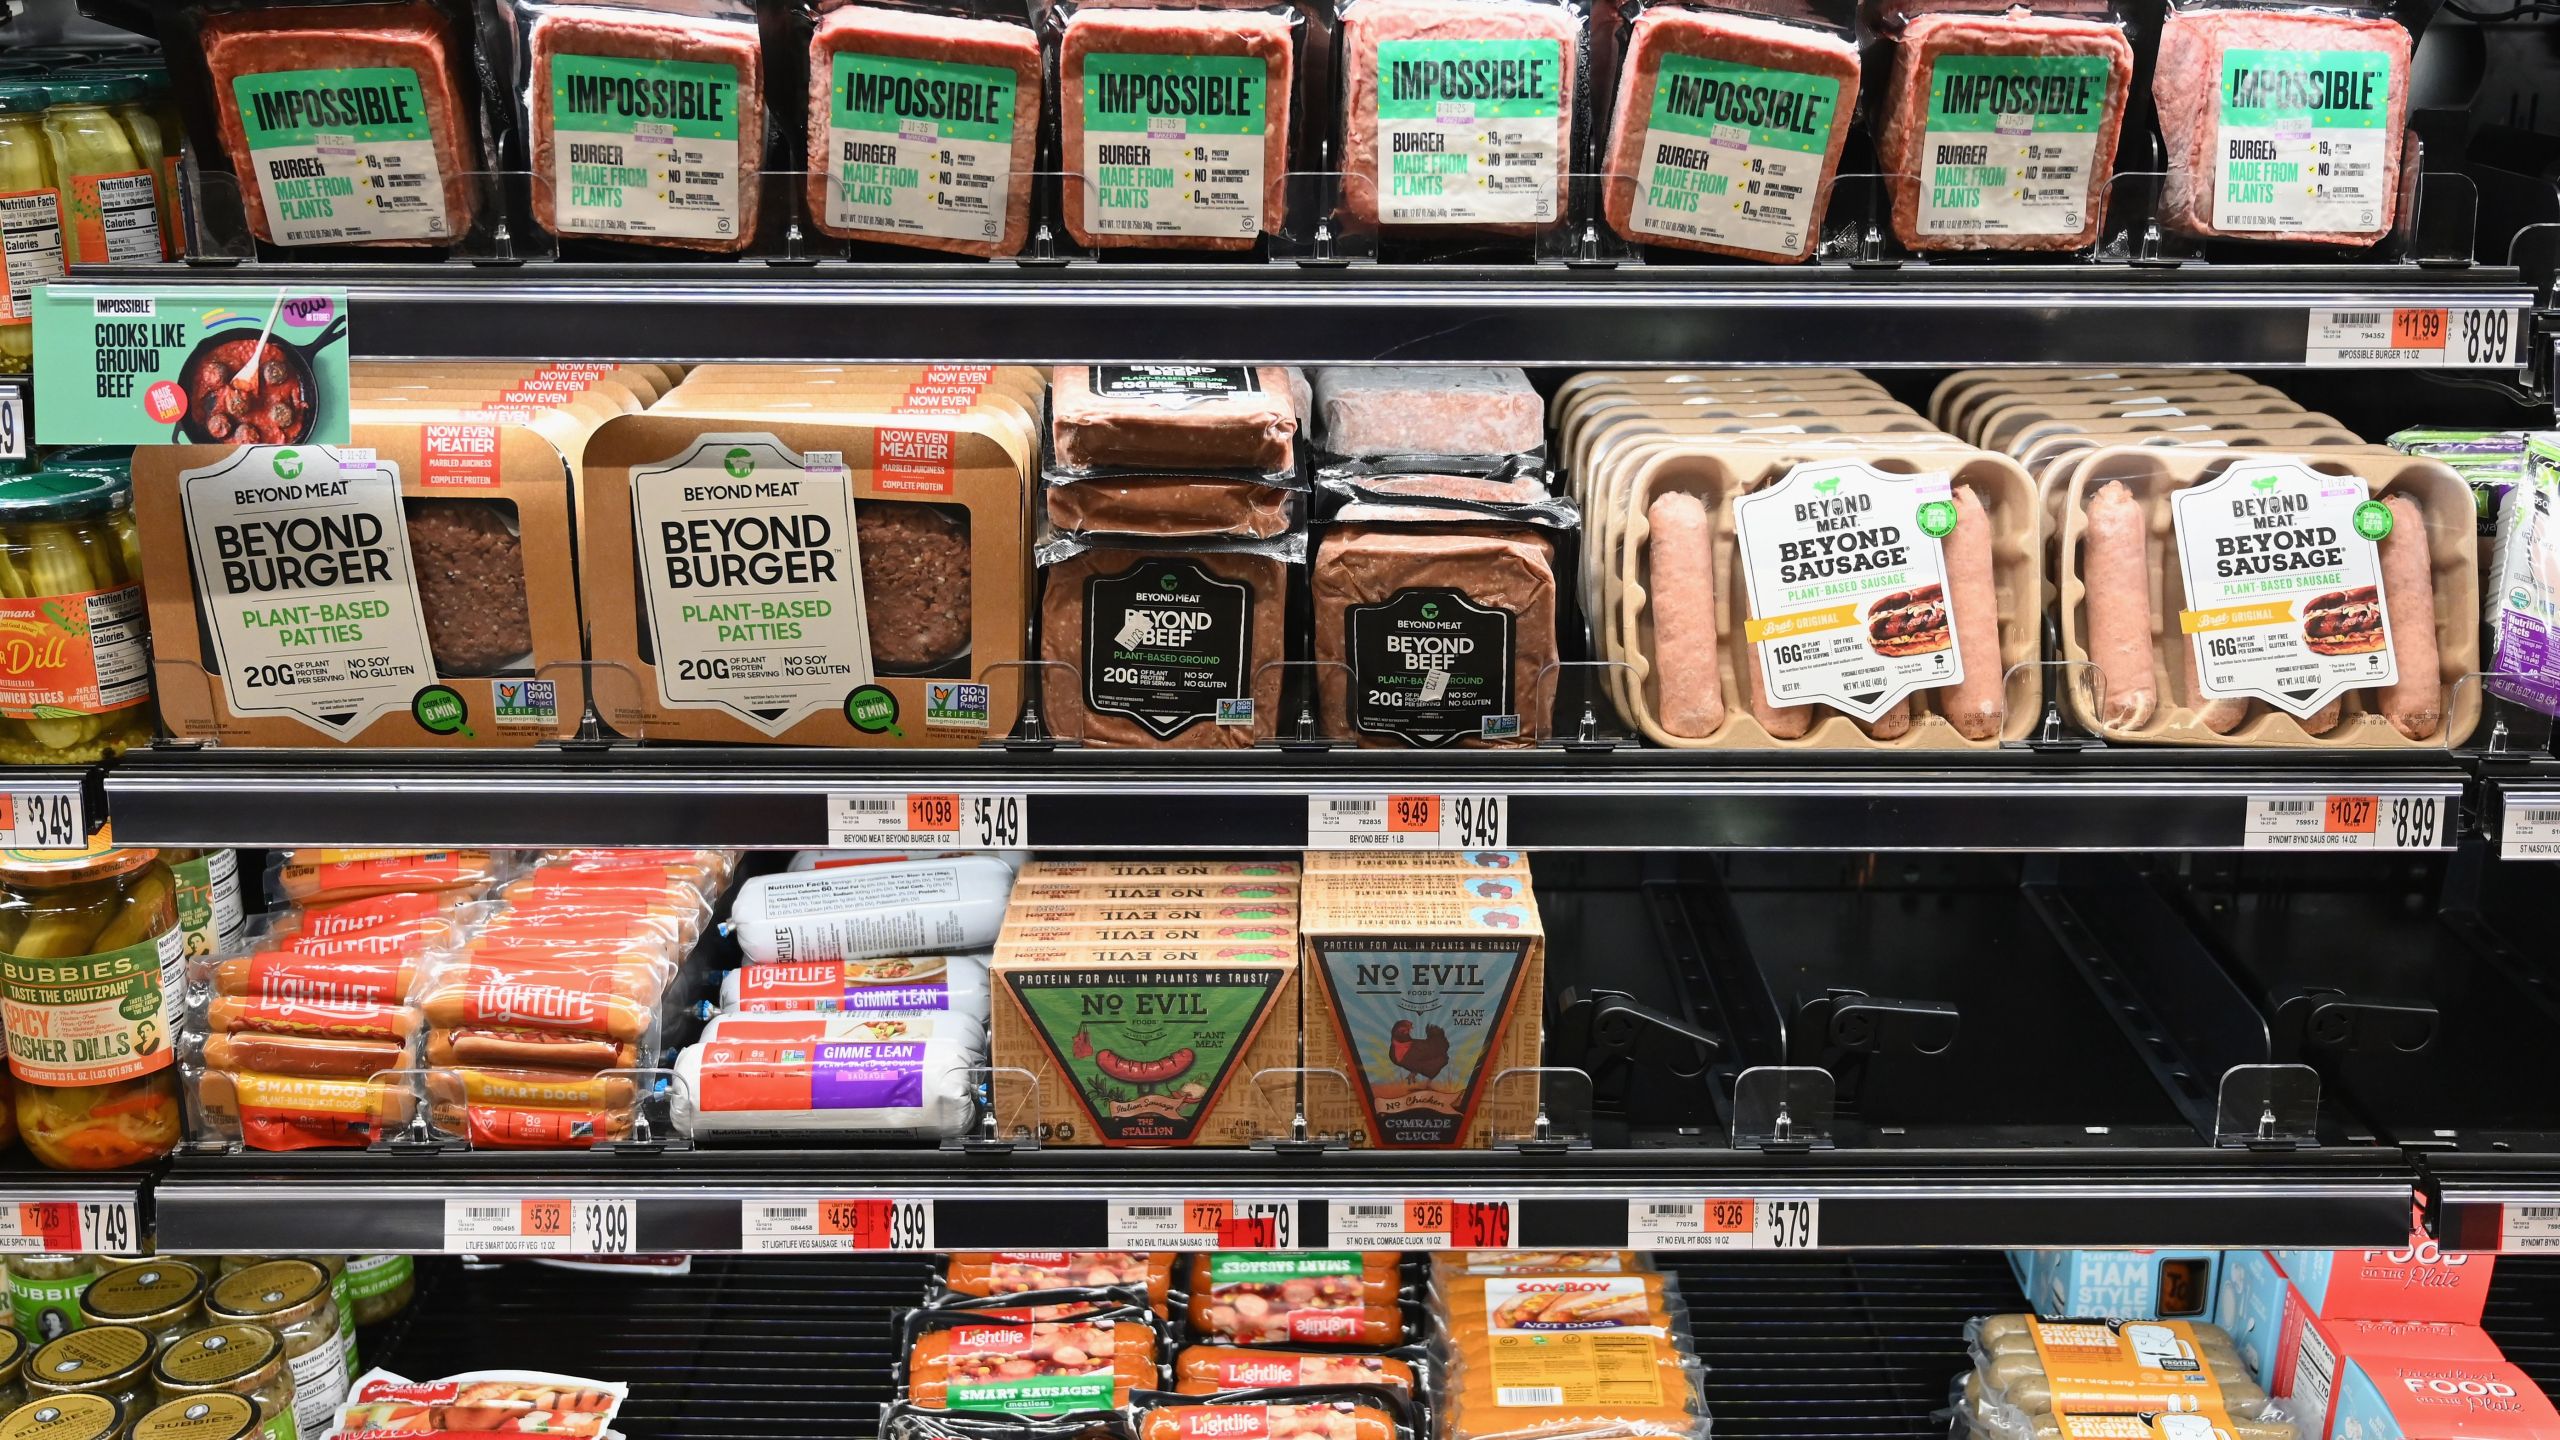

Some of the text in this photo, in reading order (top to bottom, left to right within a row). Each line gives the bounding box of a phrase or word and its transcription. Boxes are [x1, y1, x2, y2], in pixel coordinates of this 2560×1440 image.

[1393, 60, 1543, 100] IMPOSSIBLE
[2232, 69, 2375, 110] IMPOSSIBLE
[567, 75, 723, 122] IMPOSSIBLE
[846, 73, 1000, 124] IMPOSSIBLE
[1099, 74, 1251, 116] IMPOSSIBLE
[1666, 74, 1822, 135] IMPOSSIBLE
[1942, 75, 2090, 115] IMPOSSIBLE
[252, 86, 413, 131] IMPOSSIBLE
[1099, 145, 1151, 167] BURGER
[1656, 145, 1710, 171] BURGER
[99, 178, 135, 191] Nutrition
[1100, 167, 1174, 188] MADE FROM
[1194, 169, 1207, 183] NO
[1100, 189, 1149, 209] PLANTS
[105, 217, 137, 229] Calories
[97, 299, 151, 313] IMPOSSIBLE
[95, 323, 186, 348] COOKS LIKE
[2398, 313, 2440, 338] $11.99
[2462, 309, 2509, 364] $8.99
[96, 348, 160, 374] GROUND
[2338, 350, 2420, 359] IMPOSSIBLE BURGER 12 OZ
[96, 373, 135, 398] BEEF
[151, 384, 172, 400] MADE
[154, 396, 178, 411] FROM
[428, 426, 494, 438] NOW EVEN
[427, 438, 494, 453] MEATIER
[235, 481, 349, 505] BEYOND MEAT
[684, 481, 801, 502] BEYOND MEAT
[214, 512, 383, 560] BEYOND
[661, 514, 831, 554] BEYOND
[1779, 525, 1901, 563] BEYOND
[222, 548, 393, 594] BURGER
[666, 550, 838, 590] BURGER
[1780, 547, 1908, 584] SAUSAGE
[1788, 571, 1907, 602] PLANT-BASED SAUSAGE
[1136, 592, 1201, 604] BEYOND MEAT
[242, 599, 391, 629] PLANT-BASED
[1397, 619, 1463, 630] BEYOND MEAT
[2508, 614, 2546, 634] Nutrition
[279, 624, 364, 648] PATTIES
[1142, 628, 1193, 648] BEEF
[2508, 623, 2530, 638] Facts
[1387, 635, 1475, 655] BEYOND
[1773, 644, 1803, 665] 16G
[7, 639, 67, 675] Dill
[347, 656, 390, 670] NO SOY
[1113, 651, 1221, 665] PLANT-BASED GROUND
[1405, 654, 1455, 670] BEEF
[244, 663, 296, 689] 20G
[349, 664, 415, 680] NO GLUTEN
[678, 658, 730, 681] 20G
[1103, 667, 1139, 684] 20G
[28, 690, 65, 707] SLICES
[1368, 690, 1403, 707] 20G
[28, 795, 73, 846] $3.49
[913, 796, 1019, 846] $10.98 $5.49
[1397, 797, 1499, 847] $9.49 $9.49
[2330, 797, 2436, 848] $10.27 $8.99
[844, 834, 868, 843] BEYOND
[869, 834, 885, 843] MEAT
[886, 834, 909, 843] BEYOND
[911, 834, 935, 843] BURGER
[942, 834, 950, 843] OZ
[1349, 835, 1374, 844] BEYOND
[1375, 835, 1389, 844] BEEF
[1396, 835, 1404, 844] LB
[5, 957, 132, 983] BUBBIES
[1019, 974, 1072, 985] PROTEIN
[1078, 974, 1101, 984] FOR
[1136, 974, 1149, 984] IN
[1156, 973, 1199, 984] PLANTS
[1206, 973, 1221, 984] WE
[1228, 972, 1270, 984] TRUST!
[10, 983, 129, 1004] TASTE THE CHUTZPAH!
[1135, 993, 1209, 1016] EVIL
[5, 1002, 50, 1039] SPICY
[1193, 1031, 1226, 1040] PLANT
[1195, 1039, 1225, 1049] MEAT
[8, 1032, 131, 1063] KOSHER DILLS
[823, 1045, 914, 1060] GIMME LEAN
[482, 1084, 589, 1100] SMART DOGS
[1136, 1118, 1155, 1126] THE
[1395, 1130, 1442, 1141] CLUCK
[84, 1203, 128, 1251] $7.49
[530, 1208, 560, 1230] $5.32
[586, 1205, 628, 1252] $3.99
[828, 1203, 926, 1249] $4.56 $3.99
[1193, 1203, 1290, 1248] $7.72 $5.79
[1413, 1201, 1510, 1247] $9.26 $5.79
[1713, 1201, 1810, 1248] $9.26 $5.79
[1656, 1235, 1729, 1245] ST NO EVIL PIT BOSS 10 OZ
[2079, 1262, 2148, 1287] HAM
[2405, 1266, 2460, 1290] Plate
[2078, 1286, 2148, 1306] STYLE
[1523, 1320, 1619, 1330] NOT DOGS
[959, 1329, 1023, 1347] Lightlife
[959, 1386, 1100, 1401] SMART SAUSAGES
[2403, 1377, 2518, 1398] FOOD
[2468, 1395, 2525, 1414] Plate
[1190, 1413, 1261, 1436] Lightlife
